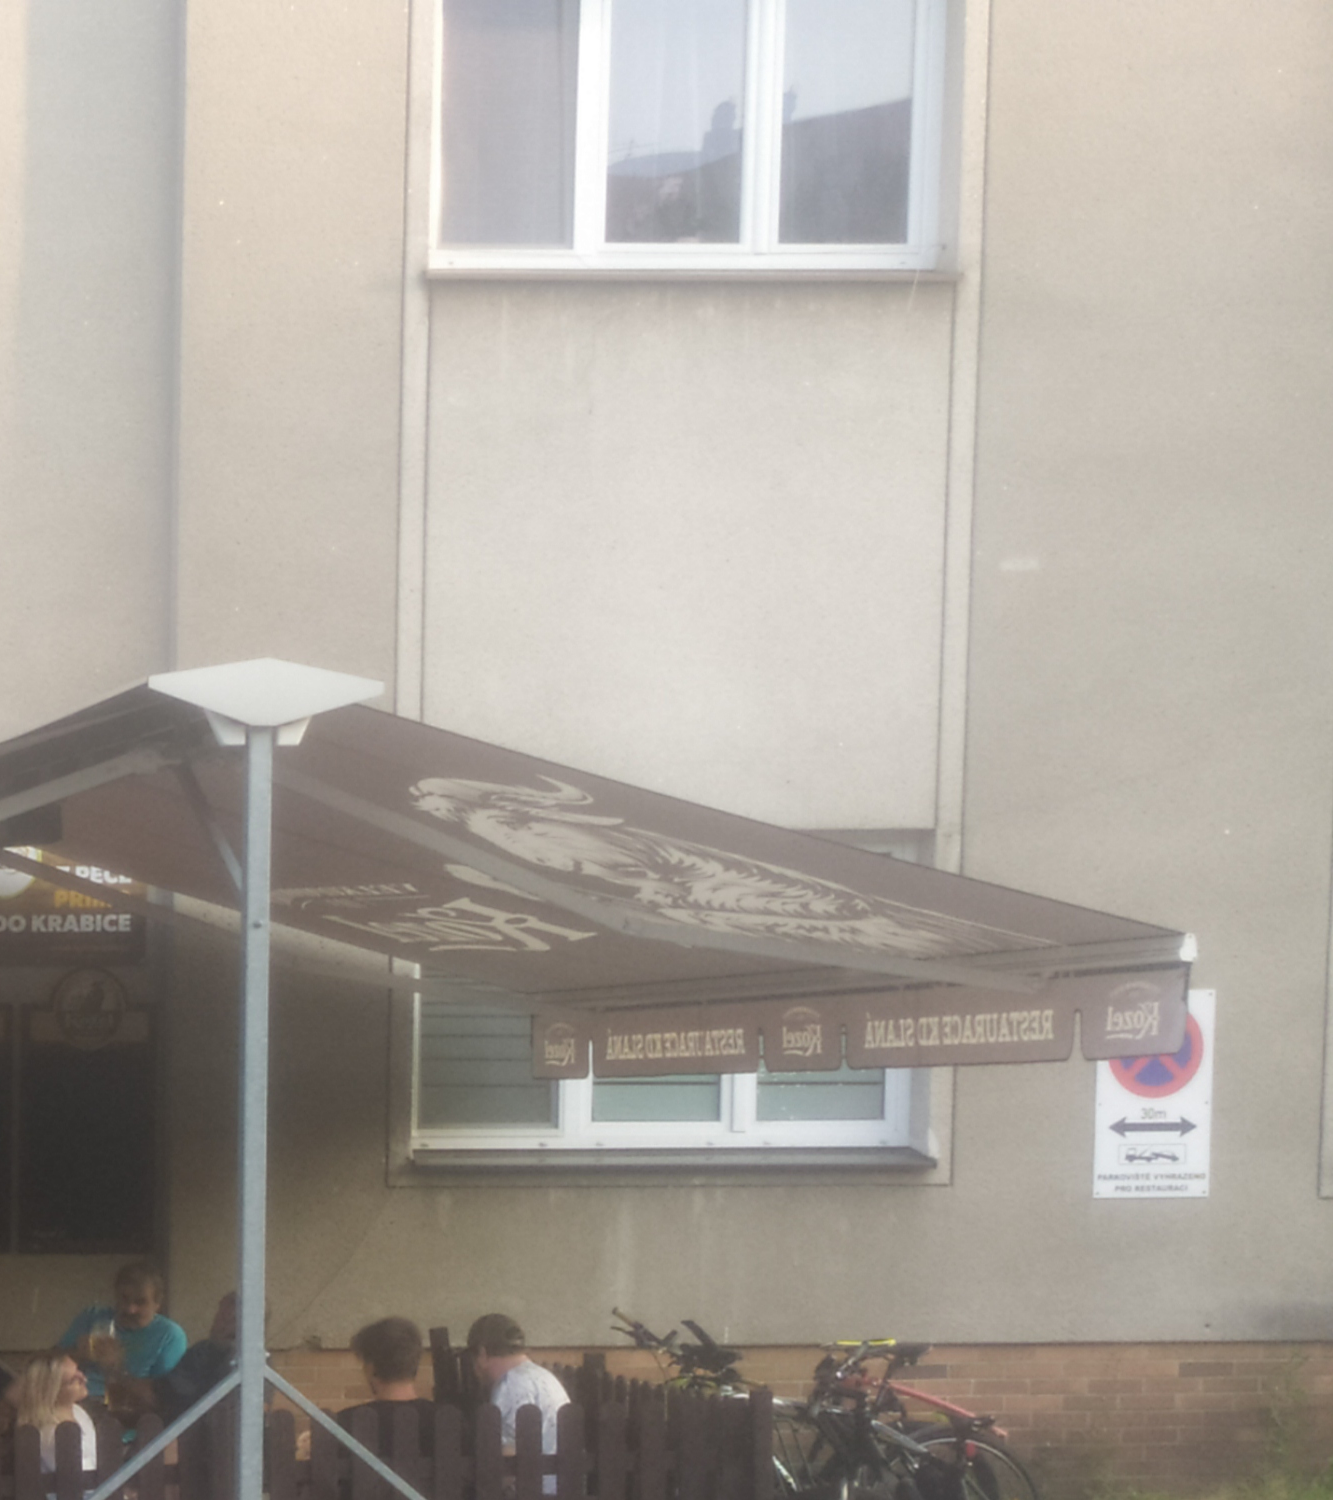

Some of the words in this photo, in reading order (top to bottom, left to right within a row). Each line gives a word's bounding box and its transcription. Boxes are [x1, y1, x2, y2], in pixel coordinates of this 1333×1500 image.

[32, 914, 131, 933] KRABICE
[1141, 1107, 1166, 1120] 30m
[1114, 1184, 1132, 1192] PRO
[1134, 1184, 1189, 1192] RESTAURACI
